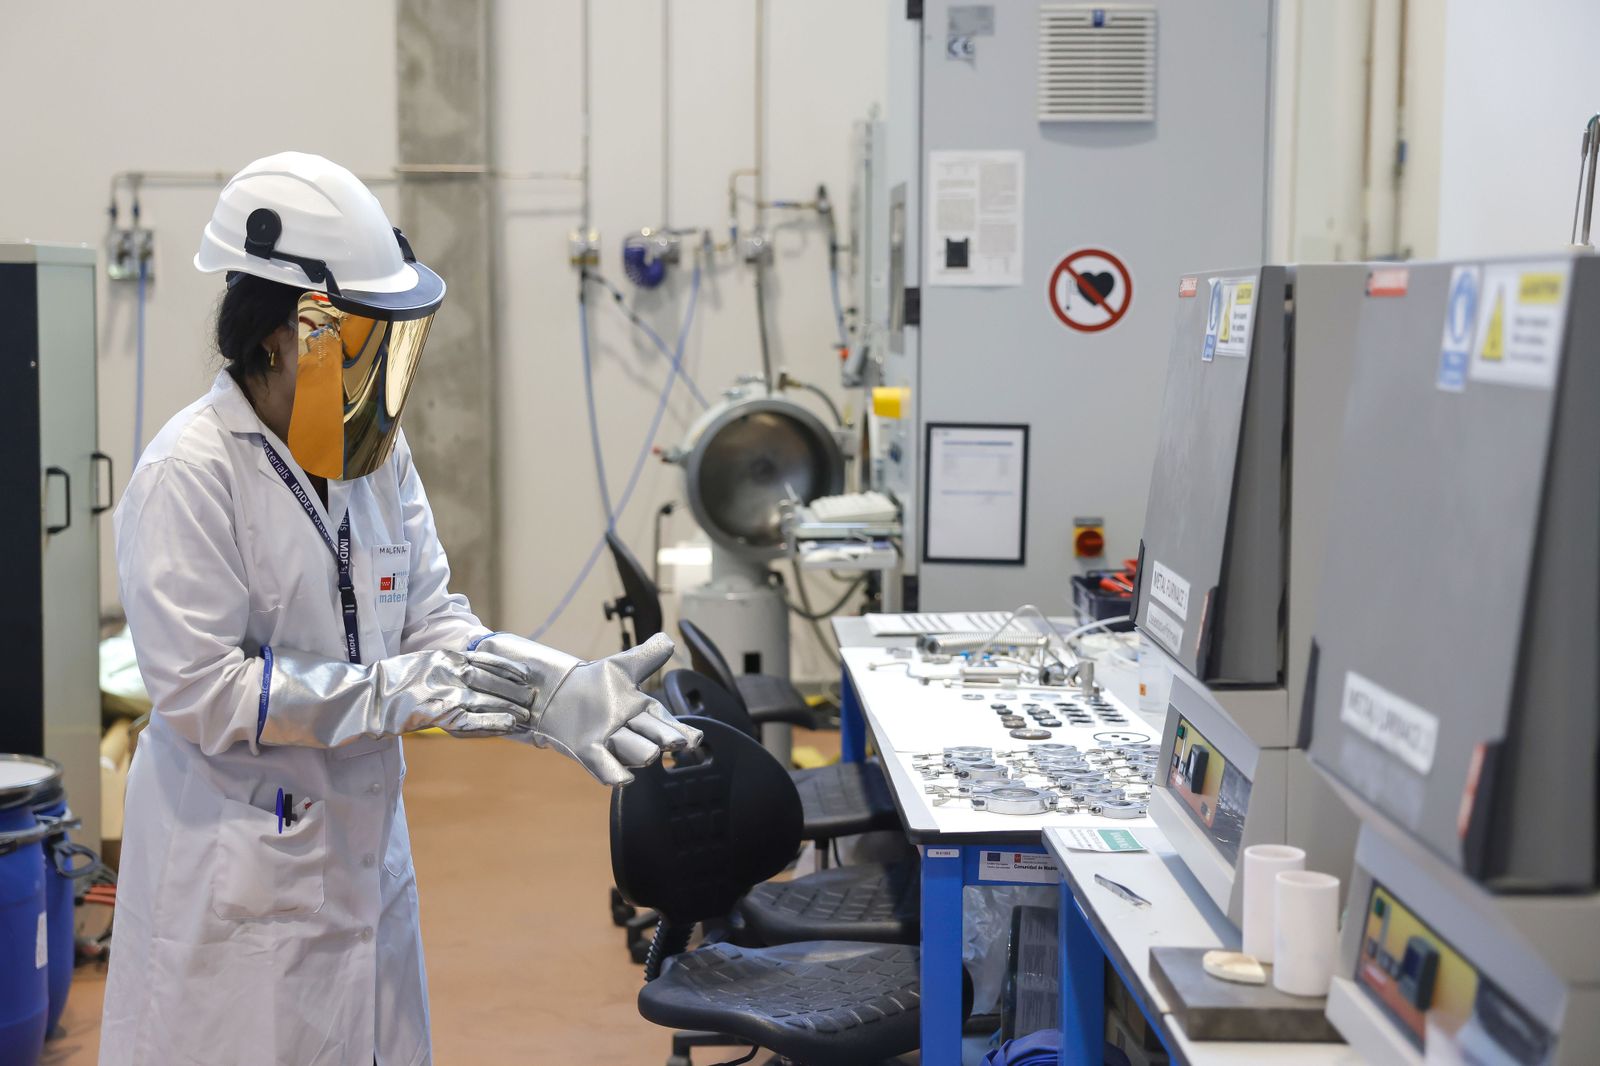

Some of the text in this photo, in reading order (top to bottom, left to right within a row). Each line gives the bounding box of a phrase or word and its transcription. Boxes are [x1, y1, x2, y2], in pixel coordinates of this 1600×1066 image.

[291, 482, 314, 516] IMDEA
[379, 546, 407, 555] MALENA
[348, 633, 357, 657] IMDEA
